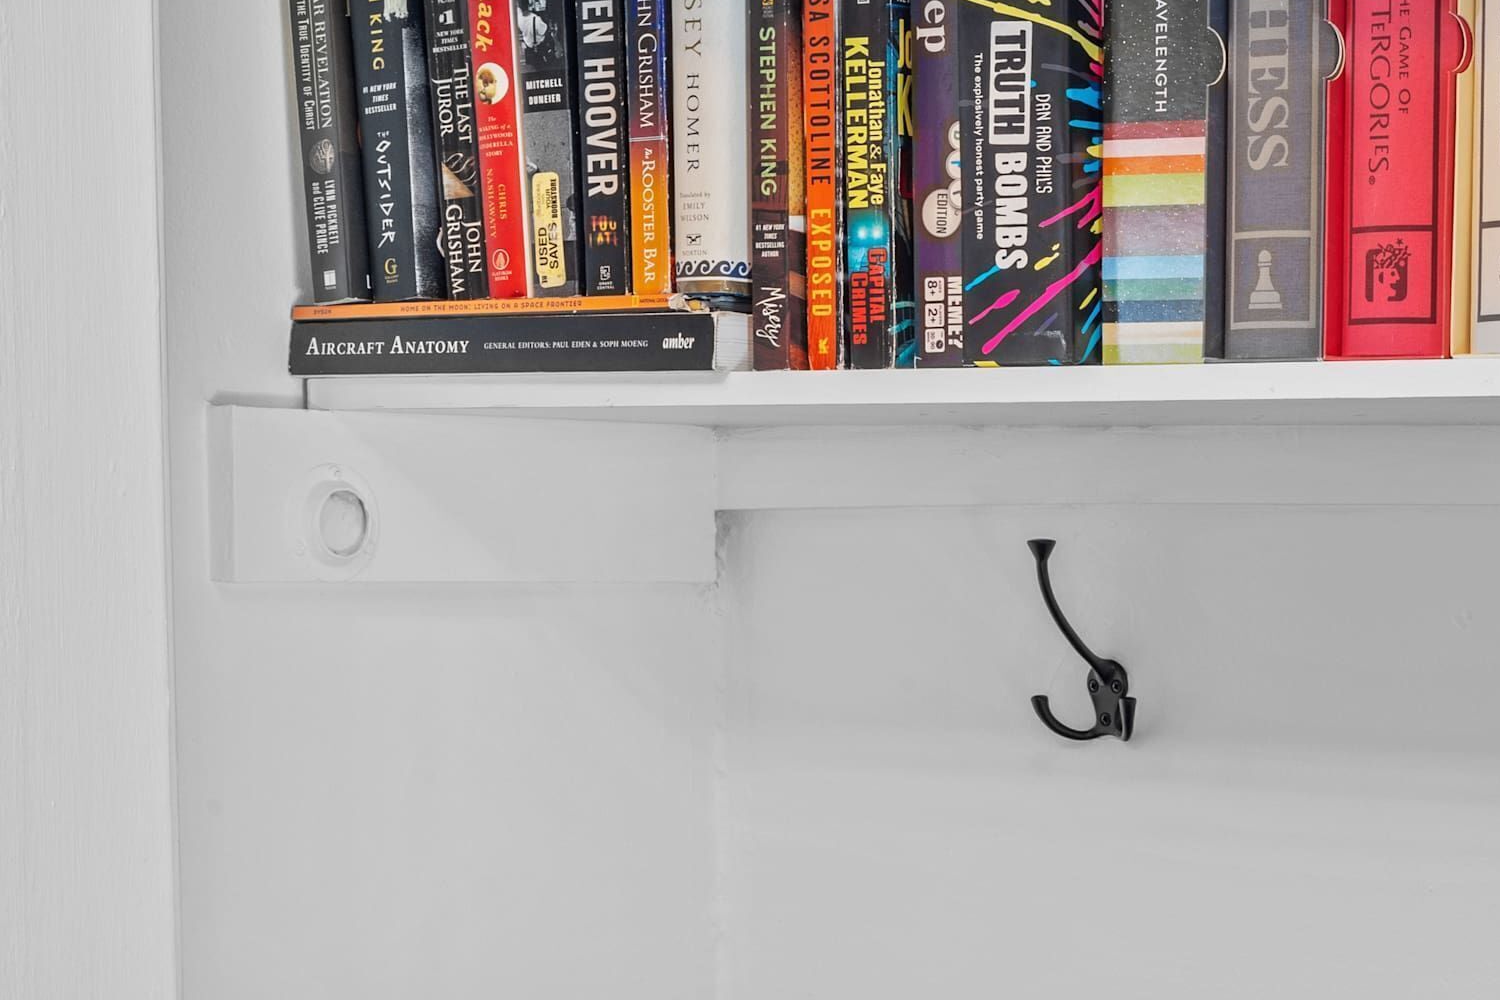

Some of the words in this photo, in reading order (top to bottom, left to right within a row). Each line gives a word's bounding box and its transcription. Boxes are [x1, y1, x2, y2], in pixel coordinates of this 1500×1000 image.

[296, 1, 306, 16] THE
[298, 18, 309, 41] TRUE
[300, 43, 311, 82] IDENTITY
[369, 13, 385, 71] KING
[974, 53, 983, 72] The
[1398, 26, 1411, 80] GAME
[303, 85, 312, 96] OF
[314, 19, 333, 129] REVELATION
[453, 62, 469, 98] THE
[525, 77, 563, 91] MITCHELL
[637, 32, 658, 129] GRISHAM
[758, 26, 777, 132] STEPHEN
[993, 29, 1026, 135] TRUTH
[304, 99, 315, 131] CHRIST
[364, 103, 397, 115] BESTSELLER
[431, 78, 454, 137] JUROR
[528, 94, 562, 106] DUNEIER
[809, 36, 831, 185] SCOTTOLINE
[868, 59, 886, 141] Jonathan
[973, 75, 985, 131] explosively
[1035, 93, 1051, 121] DAN
[1398, 88, 1412, 115] OF
[455, 102, 472, 143] LAST
[583, 56, 619, 198] HOOVER
[686, 73, 700, 174] HOMER
[844, 36, 869, 209] KELLERMAN
[1036, 125, 1052, 153] AND
[760, 138, 778, 197] KING
[974, 134, 984, 176] honest
[1035, 156, 1053, 194] PHIL'S
[324, 179, 336, 201] LYNN
[375, 139, 396, 249] OUTSIDER
[486, 168, 497, 238] NASHAWATY
[497, 184, 507, 220] CHRIS
[641, 159, 656, 244] ROOSTER
[870, 163, 887, 206] Faye
[974, 179, 984, 206] party
[313, 196, 326, 221] CLIVE
[326, 203, 340, 245] PICKNETT
[680, 213, 709, 222] WILSON
[935, 193, 948, 235] EDITION
[974, 210, 983, 240] game
[994, 151, 1028, 270] BOMBS
[315, 223, 329, 255] PRINCE
[445, 204, 465, 295] GRISHAM
[462, 217, 482, 273] JOHN
[540, 227, 548, 266] USED
[549, 222, 560, 270] SAVES
[643, 249, 658, 284] BAR
[810, 207, 833, 317] EXPOSED
[868, 248, 887, 323] CAPITAL
[755, 287, 782, 348] Misery
[851, 272, 868, 345] CRIMES
[947, 276, 963, 349] MEME?
[305, 337, 385, 356] AIRCRAFT
[389, 336, 470, 355] ANATOMY
[483, 341, 516, 350] GENERAL
[517, 340, 551, 349] EDITORS:
[552, 340, 570, 349] PAUL
[571, 340, 591, 348] EDEN
[621, 339, 649, 348] MOENG
[662, 332, 695, 350] amber
